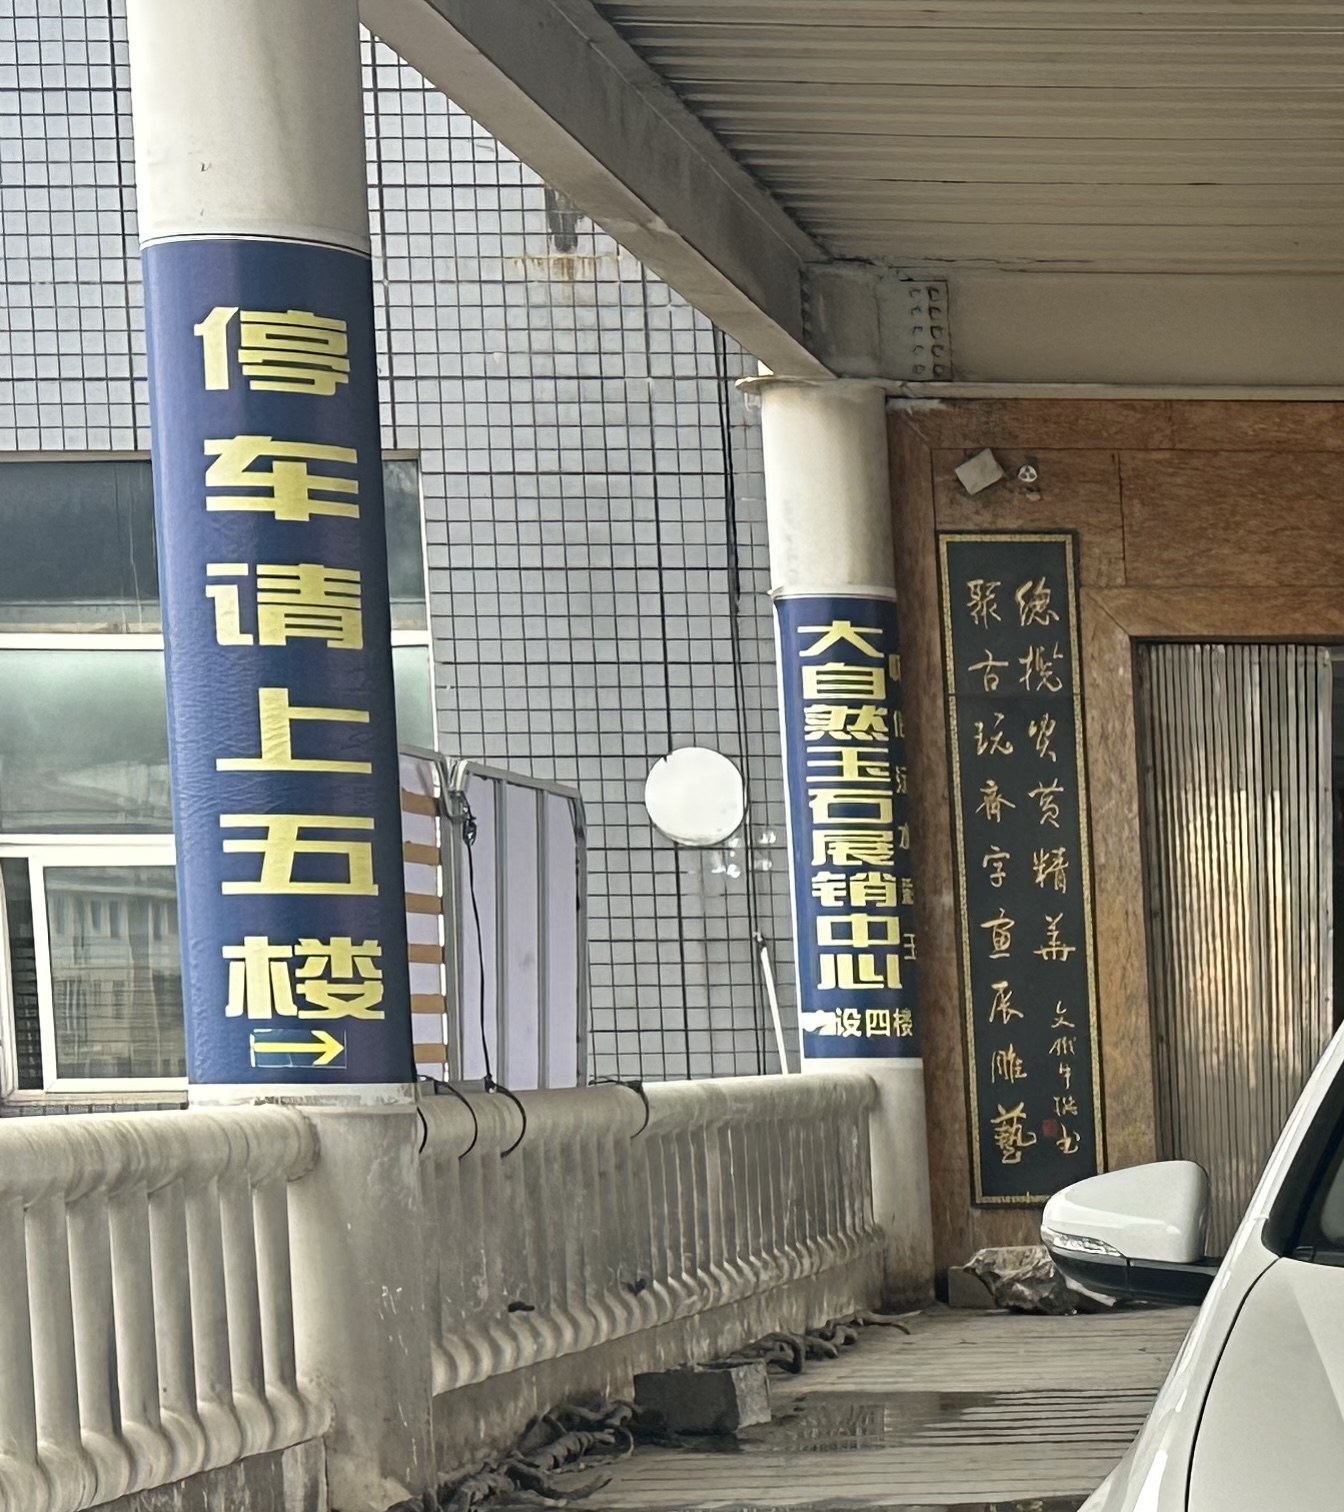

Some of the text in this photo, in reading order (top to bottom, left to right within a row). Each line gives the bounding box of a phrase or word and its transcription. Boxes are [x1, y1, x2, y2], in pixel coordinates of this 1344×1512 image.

[193, 306, 386, 1020] 停车请上五楼
[797, 619, 903, 990] 大自然玉石展销中心
